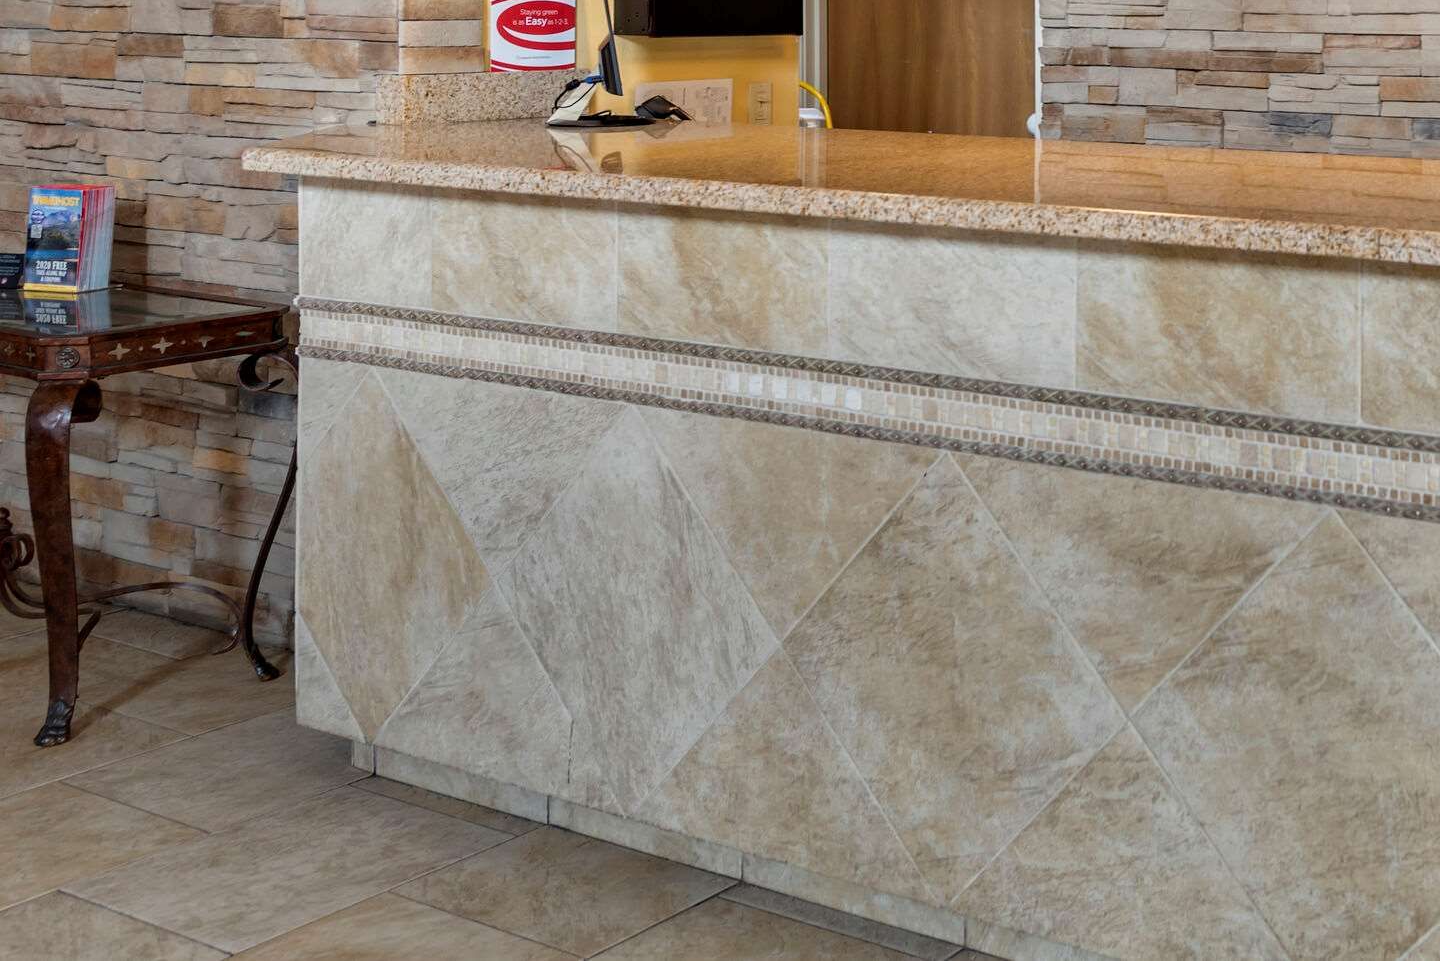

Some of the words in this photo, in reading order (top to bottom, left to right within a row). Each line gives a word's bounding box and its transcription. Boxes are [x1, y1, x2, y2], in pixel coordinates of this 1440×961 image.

[520, 8, 541, 18] Staying
[525, 16, 548, 28] Easy
[52, 260, 68, 271] FREE
